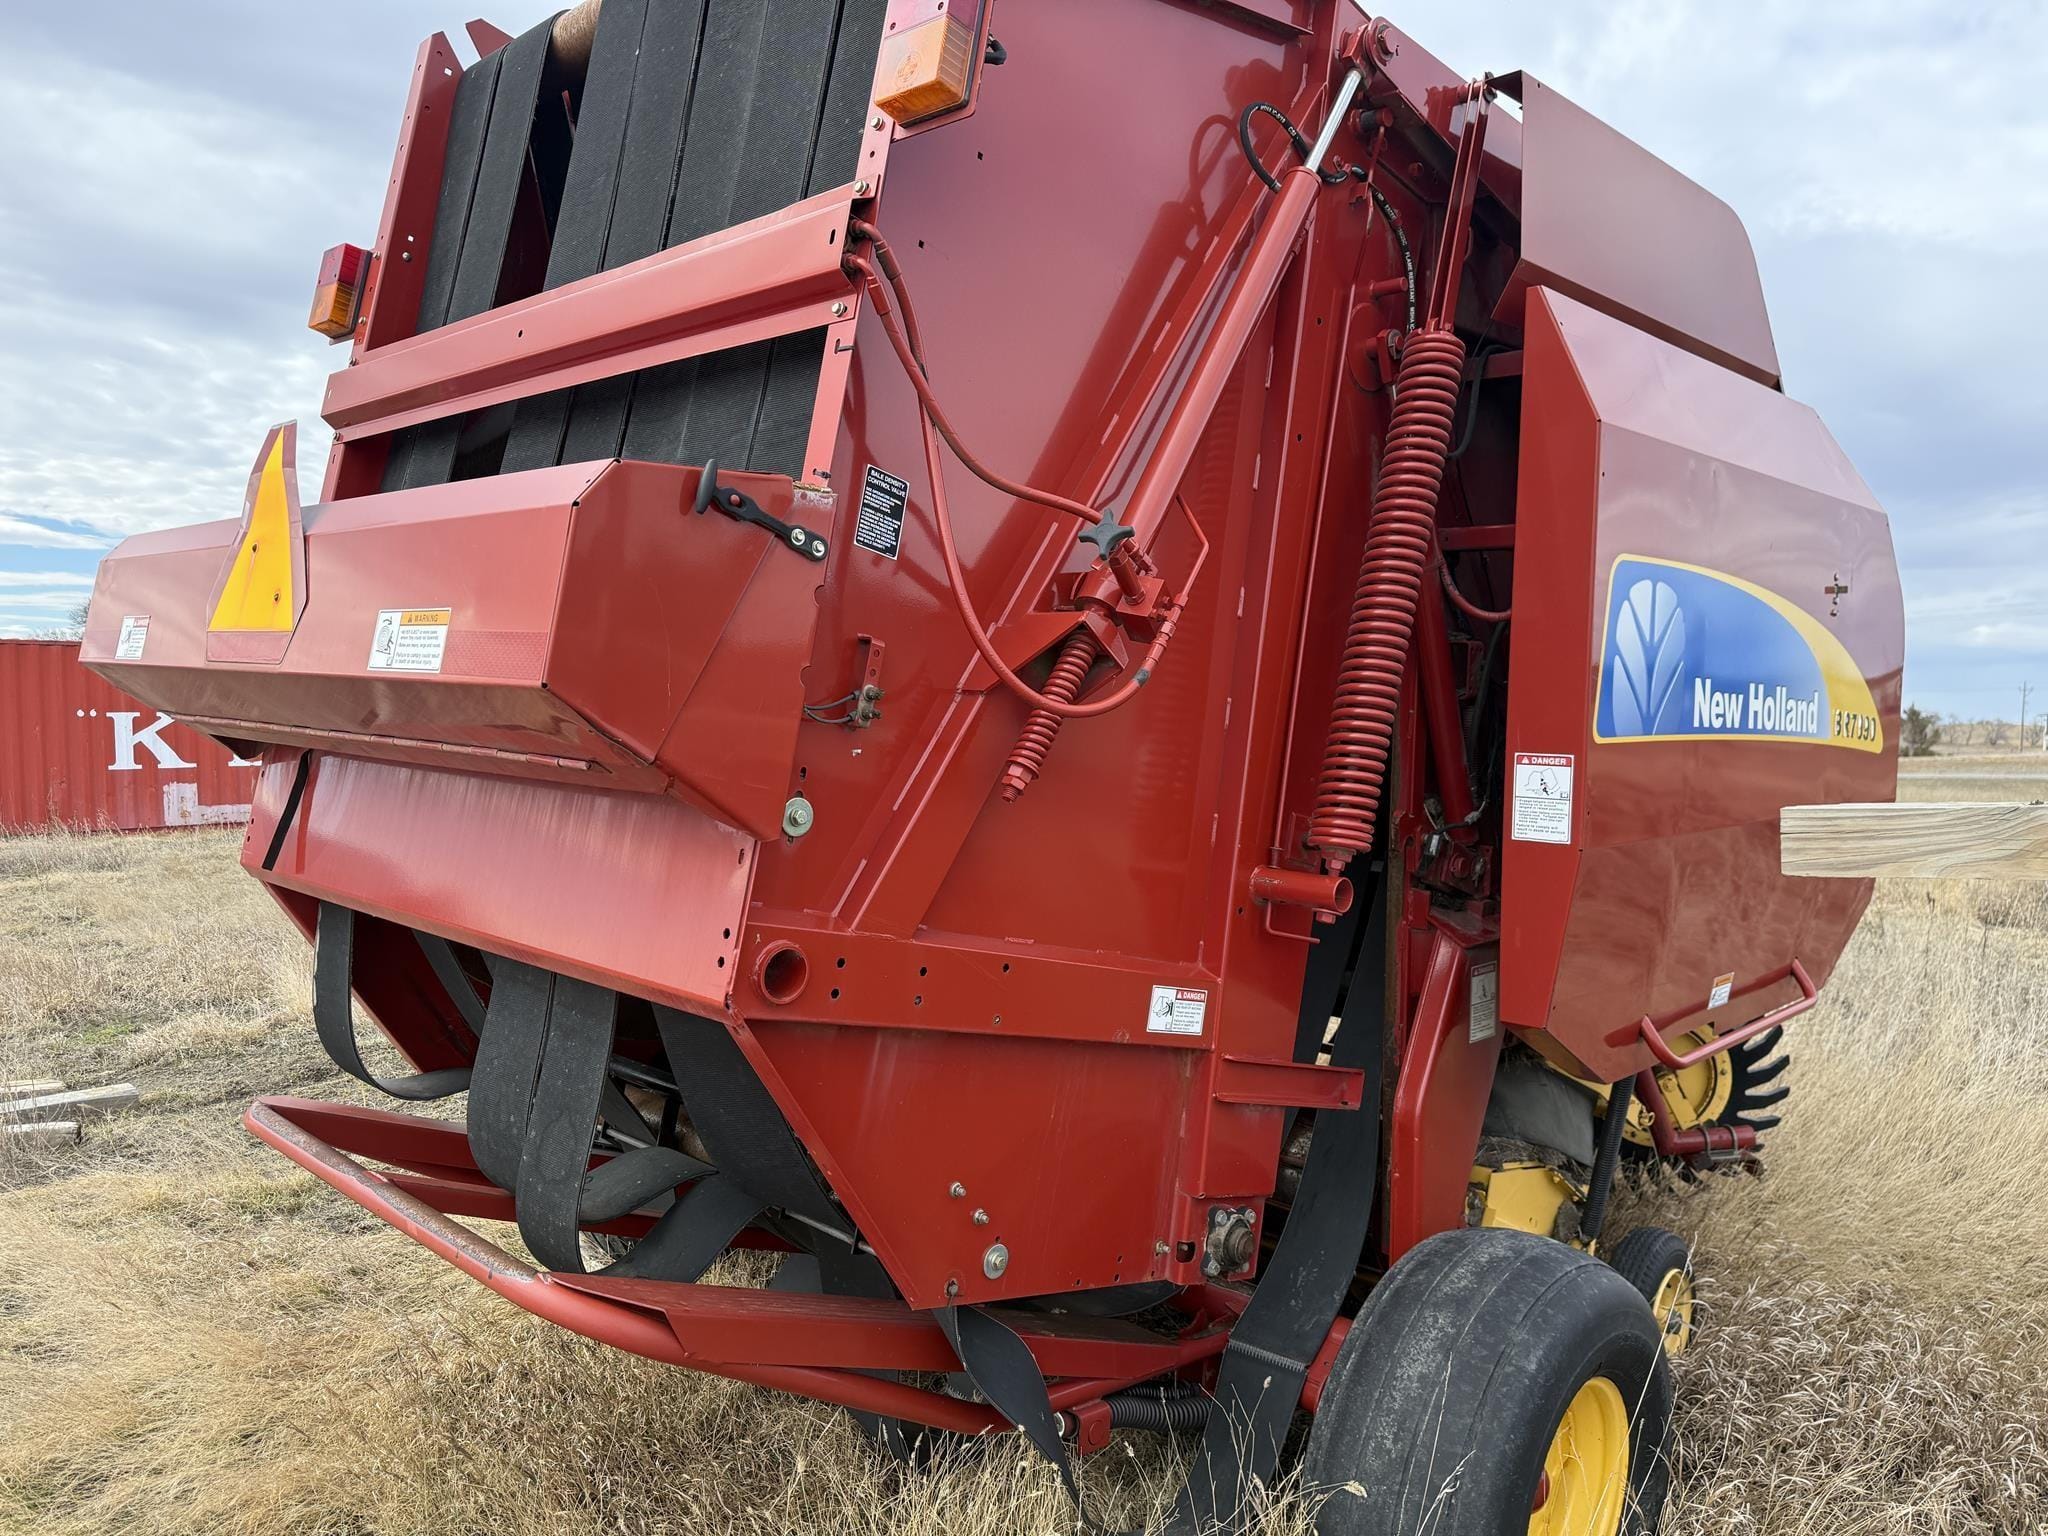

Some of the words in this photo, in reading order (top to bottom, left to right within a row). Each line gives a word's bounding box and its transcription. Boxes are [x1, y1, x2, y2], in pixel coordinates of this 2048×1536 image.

[867, 475, 891, 491] CONTROL
[891, 486, 905, 497] VALVE
[870, 469, 884, 481] BALE
[884, 474, 905, 489] DENSITY
[414, 614, 439, 623] WARNING
[1693, 677, 1744, 729] New
[1748, 682, 1819, 734] Holland
[1531, 756, 1567, 766] DANGER
[1183, 991, 1205, 1001] DANGER
